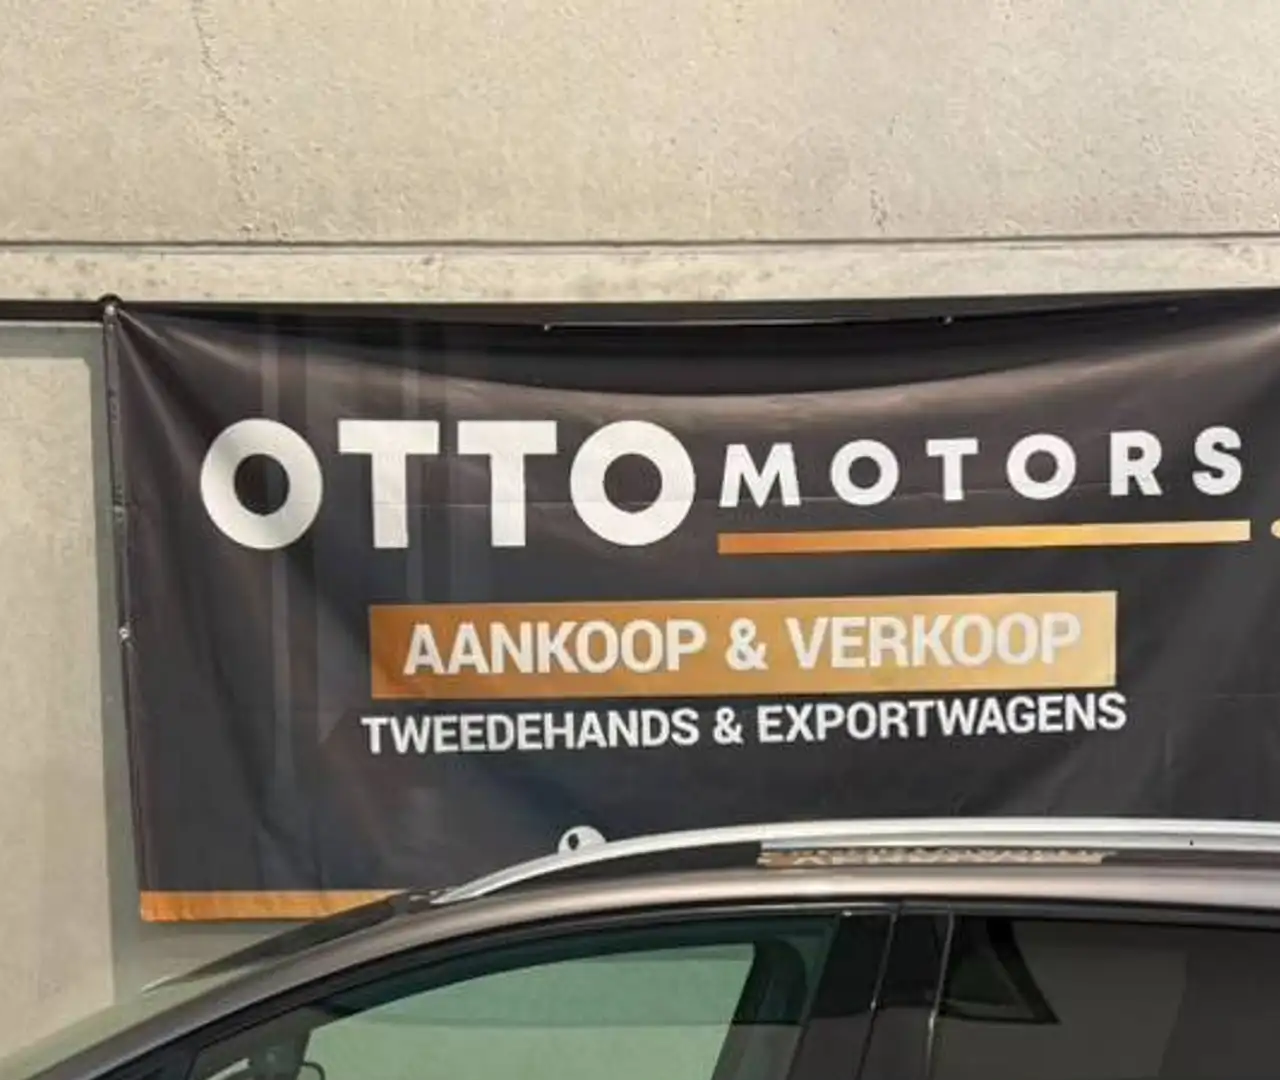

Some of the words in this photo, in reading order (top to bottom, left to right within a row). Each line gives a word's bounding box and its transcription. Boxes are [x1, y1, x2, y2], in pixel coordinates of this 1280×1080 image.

[200, 417, 696, 550] OTTO
[718, 426, 1243, 508] MOTORS
[402, 619, 707, 675] AANKOOP
[725, 618, 769, 671] &
[784, 611, 1082, 669] VERKOOP
[361, 707, 701, 754] TWEEDEHANDS
[712, 706, 744, 746] &
[756, 691, 1128, 744] EXPORTWAGENS
